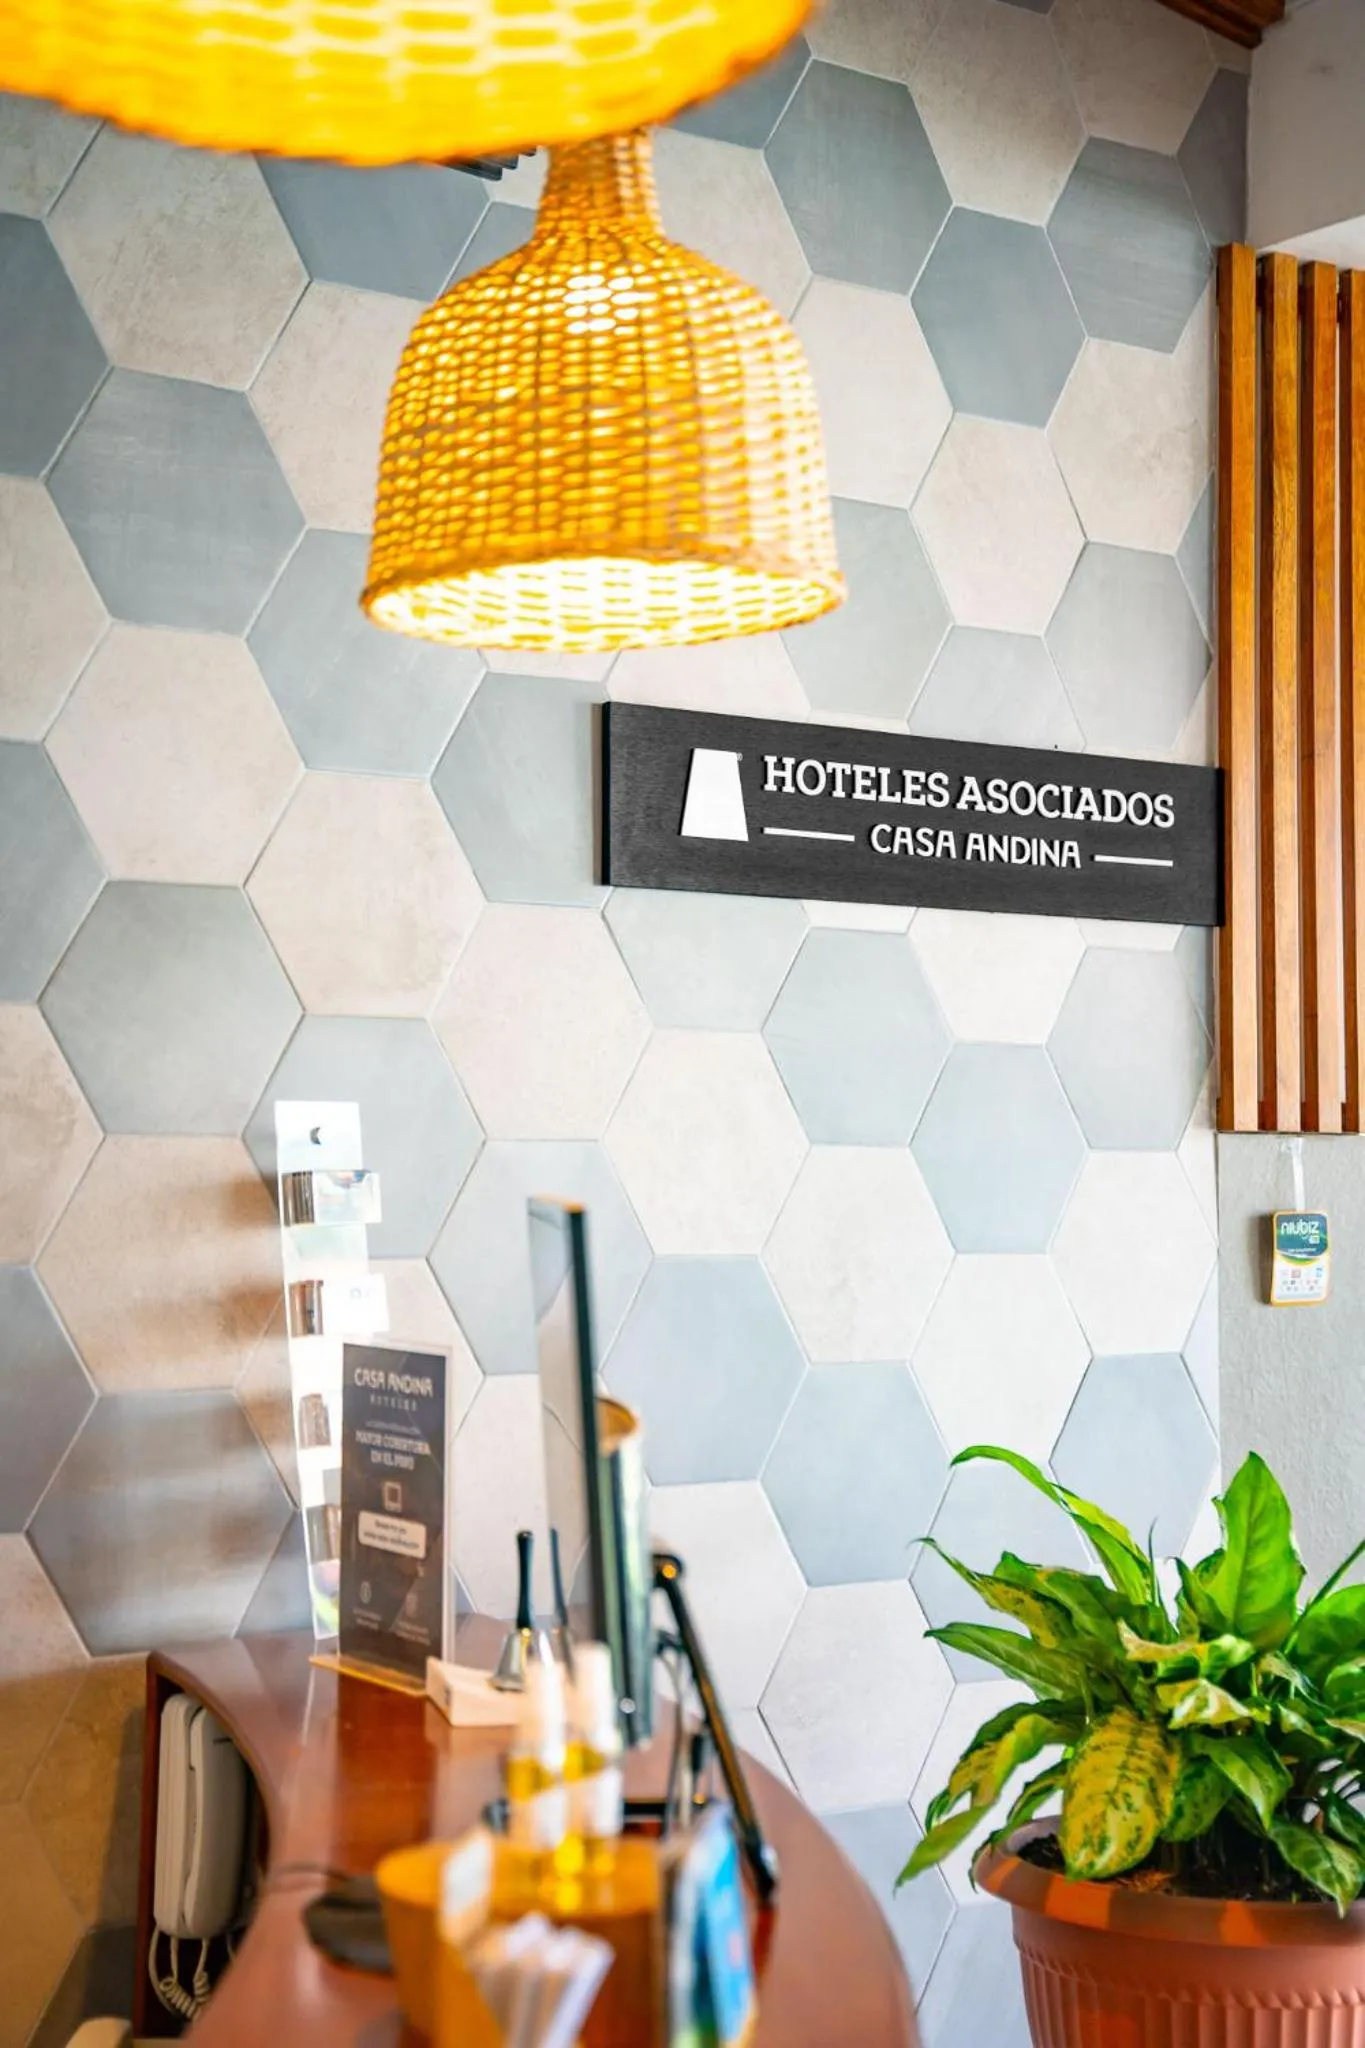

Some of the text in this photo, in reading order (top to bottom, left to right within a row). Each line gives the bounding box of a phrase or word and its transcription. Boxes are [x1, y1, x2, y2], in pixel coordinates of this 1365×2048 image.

[763, 754, 1176, 830] HOTELES ASOCIADOS
[870, 823, 1082, 869] CASA ANDINA
[1280, 1218, 1320, 1236] niubiz
[354, 1367, 434, 1397] CASA ANDINA
